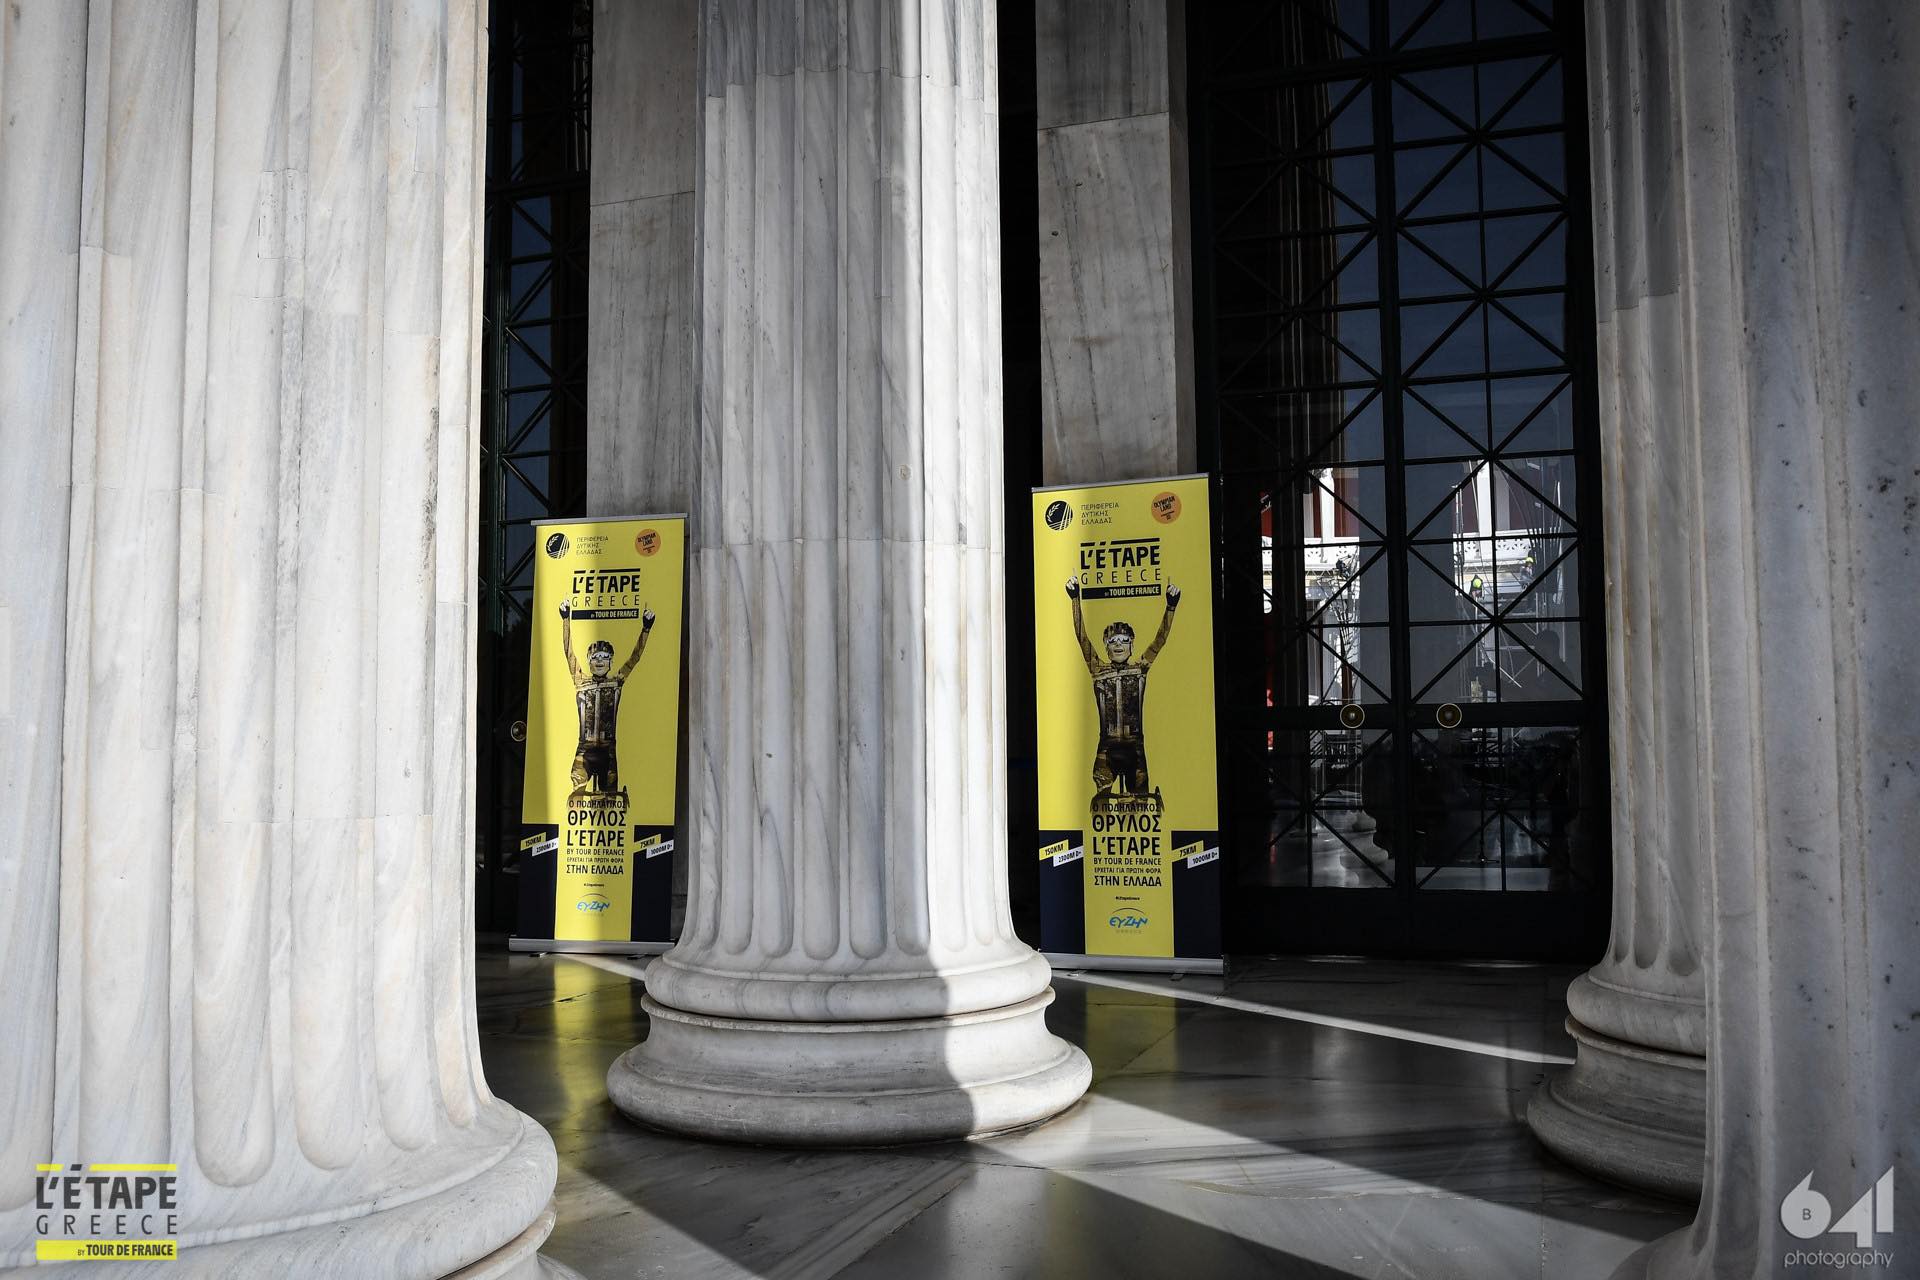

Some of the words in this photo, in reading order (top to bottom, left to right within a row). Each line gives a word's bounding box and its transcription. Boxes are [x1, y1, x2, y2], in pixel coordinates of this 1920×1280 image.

[1081, 502, 1120, 510] ΠΕΡΙΦΕΡΕΙΑ
[1081, 510, 1108, 518] ΔΥΤΙΚΗΣ
[1081, 569, 1161, 585] GREECE
[1110, 588, 1126, 596] TOUR
[1126, 588, 1135, 596] DE
[1135, 586, 1160, 595] FRANCE
[572, 595, 640, 607] GREECE
[610, 610, 617, 618] DE
[568, 811, 626, 826] ΘΡΥΛΟΣ
[1092, 815, 1161, 833] ΘΡΥΛΟΣ
[567, 830, 624, 847] L'ETAPE
[1093, 837, 1160, 855] L'ETAPE
[566, 865, 588, 874] ΣΤΗΝ
[591, 865, 624, 875] ΕΛΛΑΔΑ
[1094, 876, 1120, 886] ΣΤΗΝ
[1123, 876, 1162, 886] ΕΛΛΑΔΑ
